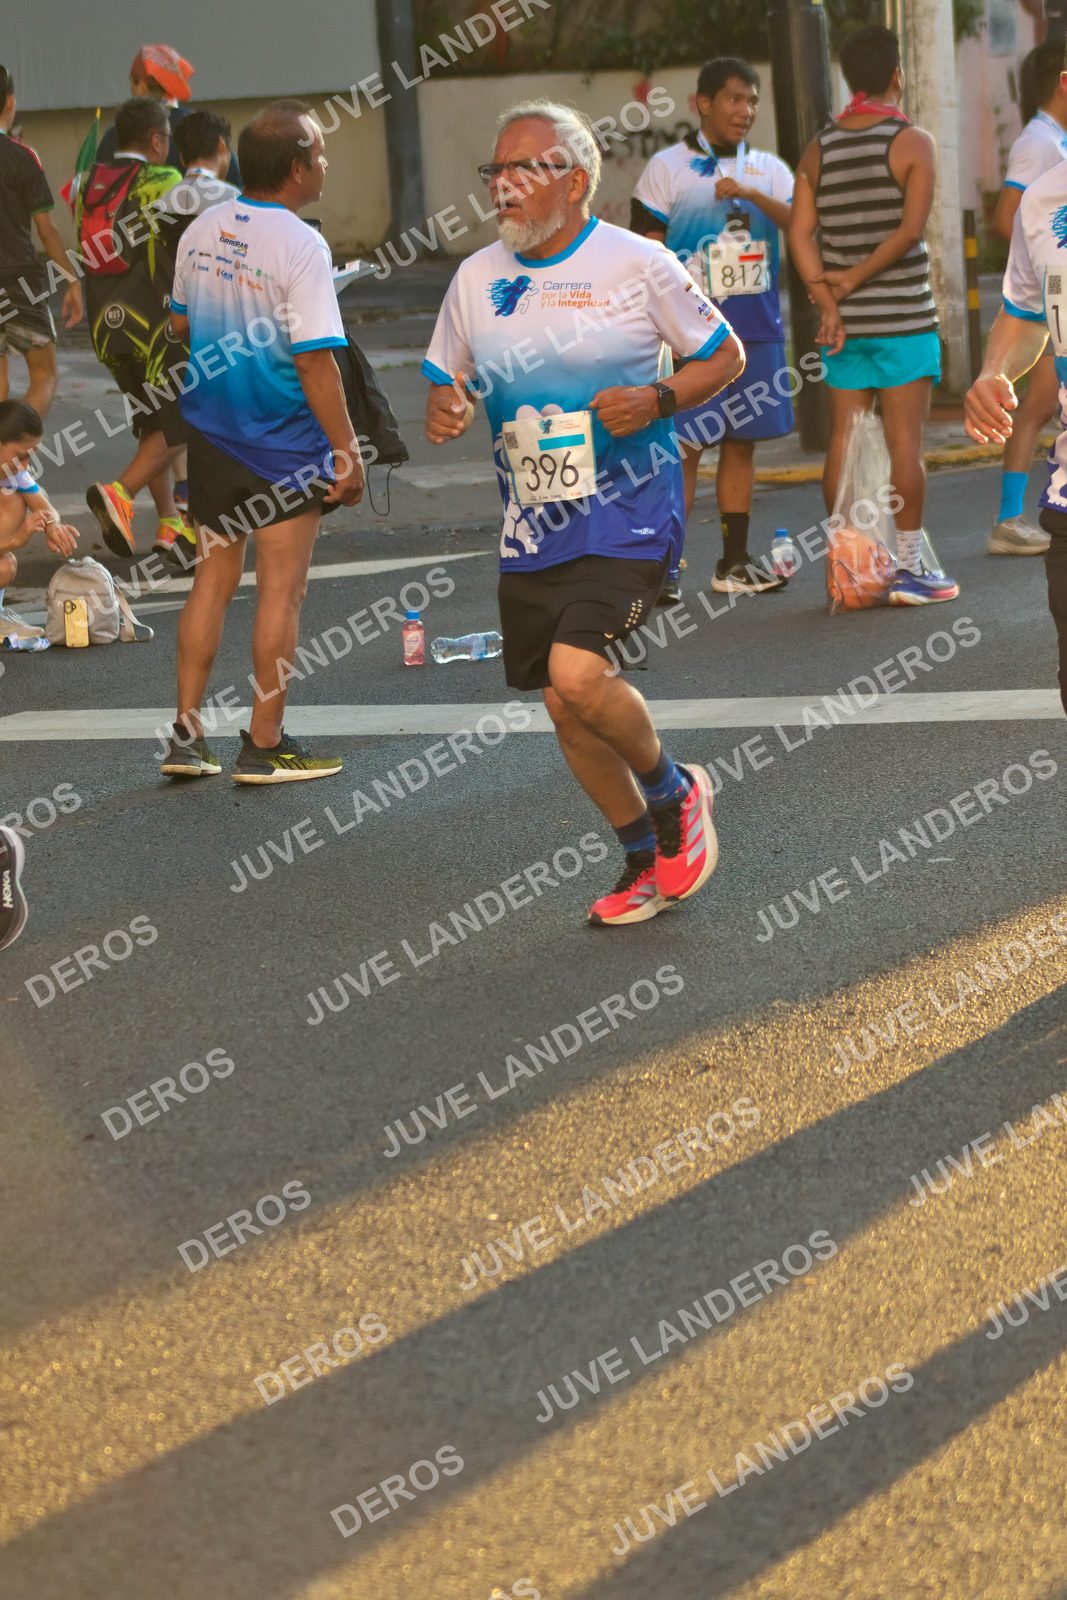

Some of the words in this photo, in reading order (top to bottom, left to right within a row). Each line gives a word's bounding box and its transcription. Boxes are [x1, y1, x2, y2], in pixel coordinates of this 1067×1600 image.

[721, 264, 762, 288] 812
[542, 281, 592, 290] Carrera
[541, 292, 557, 300] por
[559, 291, 568, 299] la
[569, 291, 592, 299] Vida
[558, 299, 610, 310] Integridad
[521, 450, 579, 491] 396
[2, 869, 14, 908] HOKA
